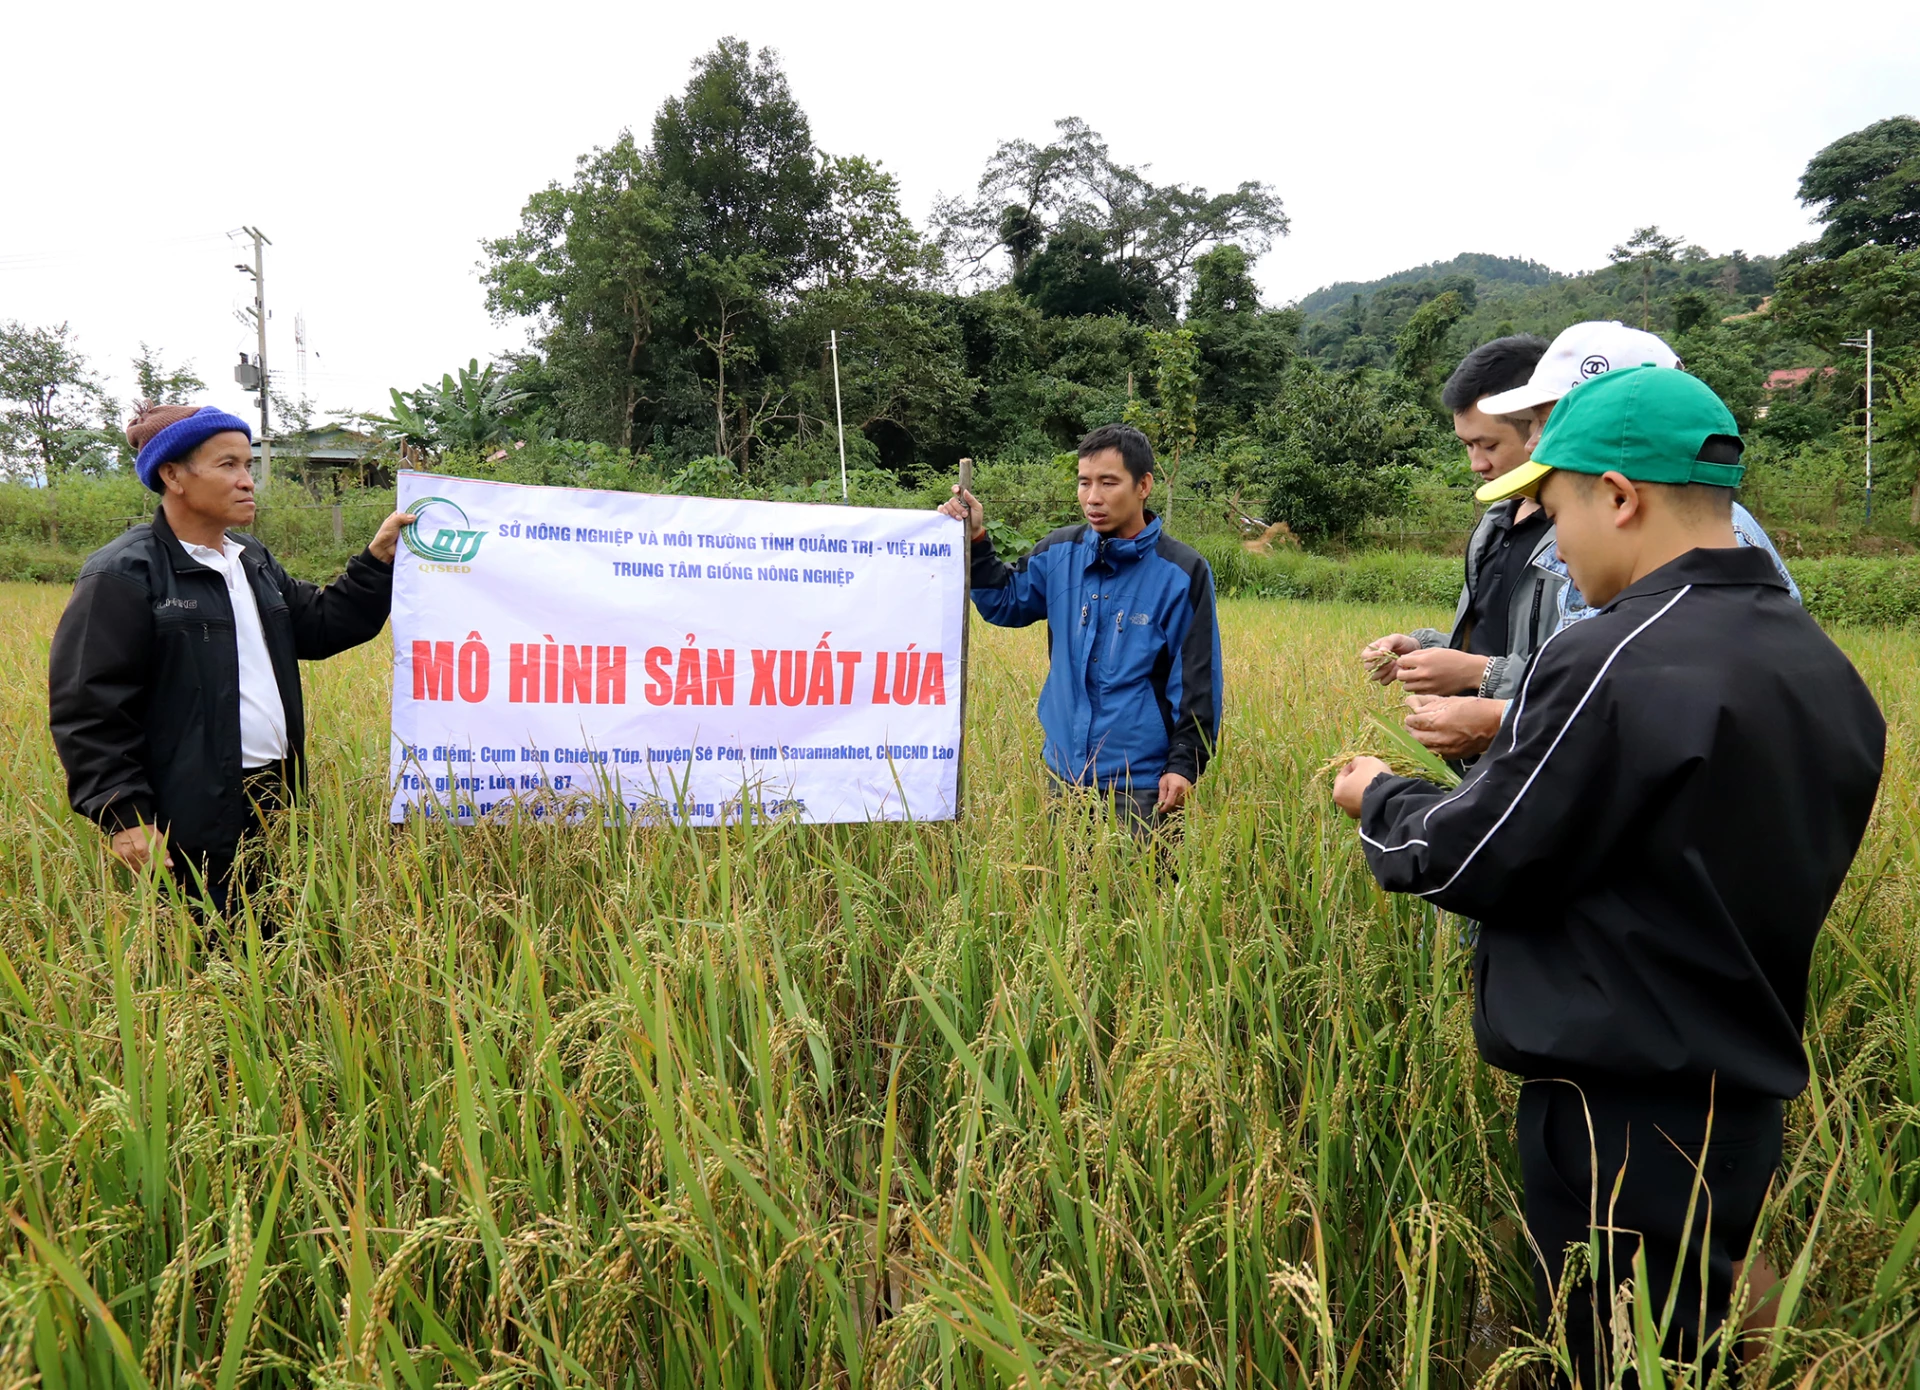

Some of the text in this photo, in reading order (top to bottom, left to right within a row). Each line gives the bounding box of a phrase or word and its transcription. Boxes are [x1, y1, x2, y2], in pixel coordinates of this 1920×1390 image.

[499, 520, 521, 538] SỞ
[525, 523, 571, 542] NÔNG
[576, 528, 634, 547] NGHIỆP
[638, 530, 658, 546] VÀ
[663, 531, 693, 547] MÔI
[697, 533, 757, 550] TRƯỜNG
[761, 532, 794, 551] TỈNH
[799, 533, 848, 554] QUẢNG
[851, 540, 873, 557] TRỊ
[886, 539, 916, 558] VIỆT
[919, 542, 952, 557] NAM
[418, 563, 471, 574] QTSEED
[613, 561, 855, 587] TRUNG TÂM GIỐNG NÔNG NGHIỆP
[412, 630, 947, 707] MÔ HÌNH SẢN XUẤT LÚA
[554, 747, 608, 765] Chiêng
[613, 747, 642, 764] Túp,
[647, 746, 691, 765] huyện
[695, 746, 713, 761] Sê
[750, 745, 777, 761] tỉnh
[781, 745, 873, 761] Savannakhet,
[876, 745, 928, 760] CHDCND
[932, 745, 954, 760] Lào
[489, 774, 516, 790] Lúa
[554, 775, 572, 791] 87
[672, 803, 714, 817] tng
[770, 799, 805, 815] 205
